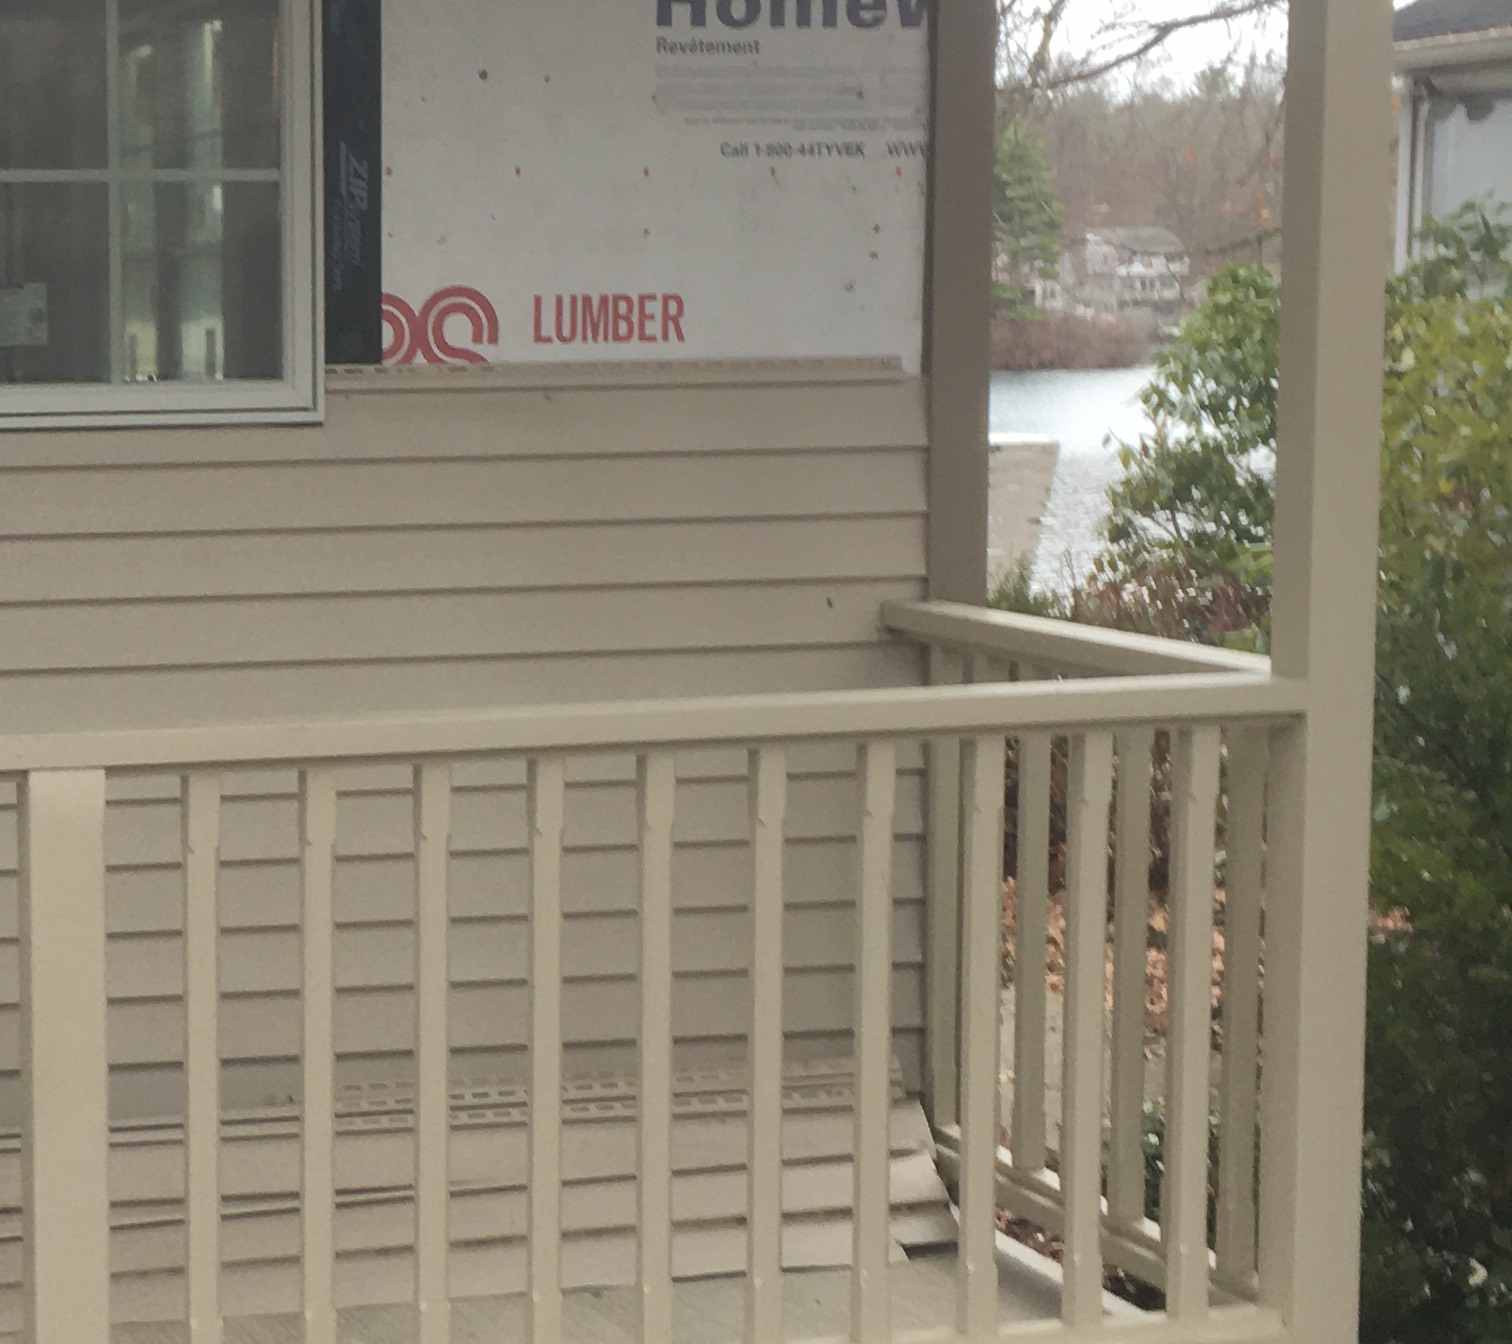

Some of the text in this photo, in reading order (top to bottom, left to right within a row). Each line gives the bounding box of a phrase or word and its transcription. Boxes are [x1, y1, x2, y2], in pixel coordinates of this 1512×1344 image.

[655, 36, 761, 56] Revêtement
[719, 141, 749, 158] Call
[533, 293, 686, 344] LUMBER
